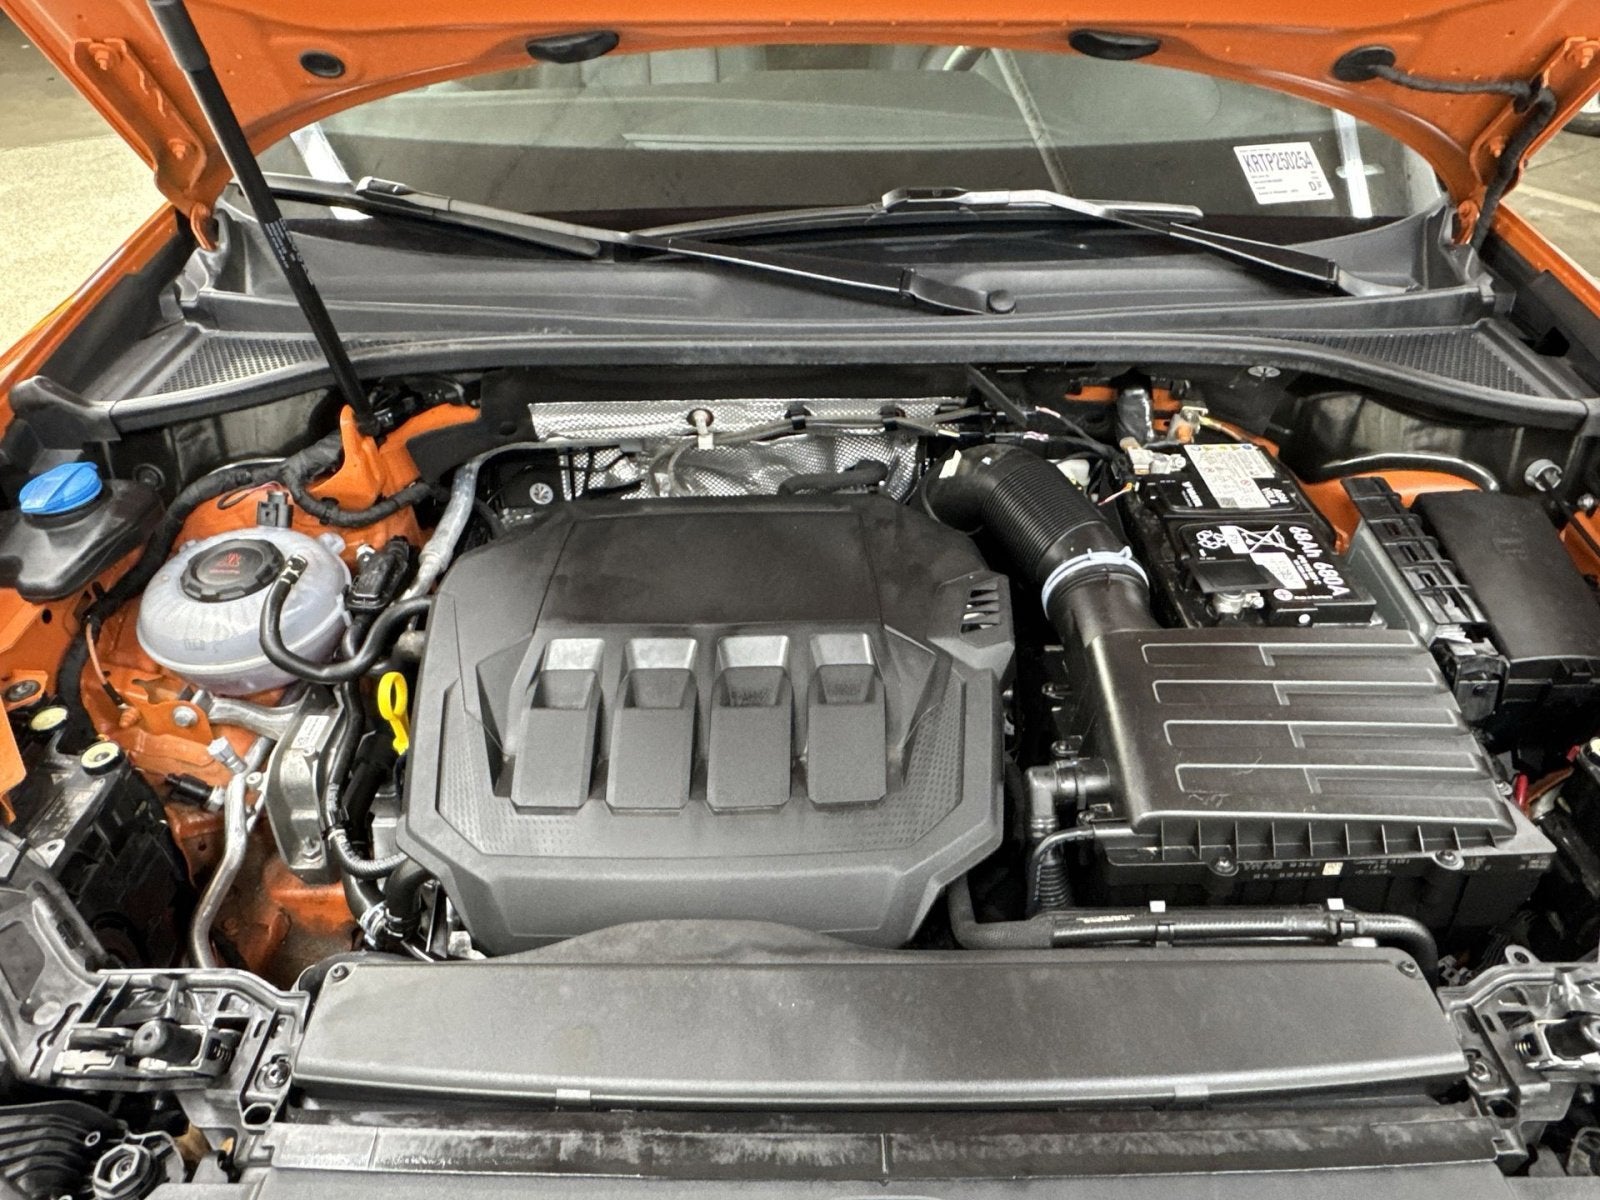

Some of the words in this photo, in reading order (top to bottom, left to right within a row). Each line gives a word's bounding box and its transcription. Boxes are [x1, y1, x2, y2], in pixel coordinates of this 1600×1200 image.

[1243, 151, 1312, 173] KRTP250254
[1288, 526, 1324, 558] 68Ah
[1313, 561, 1350, 596] 680A
